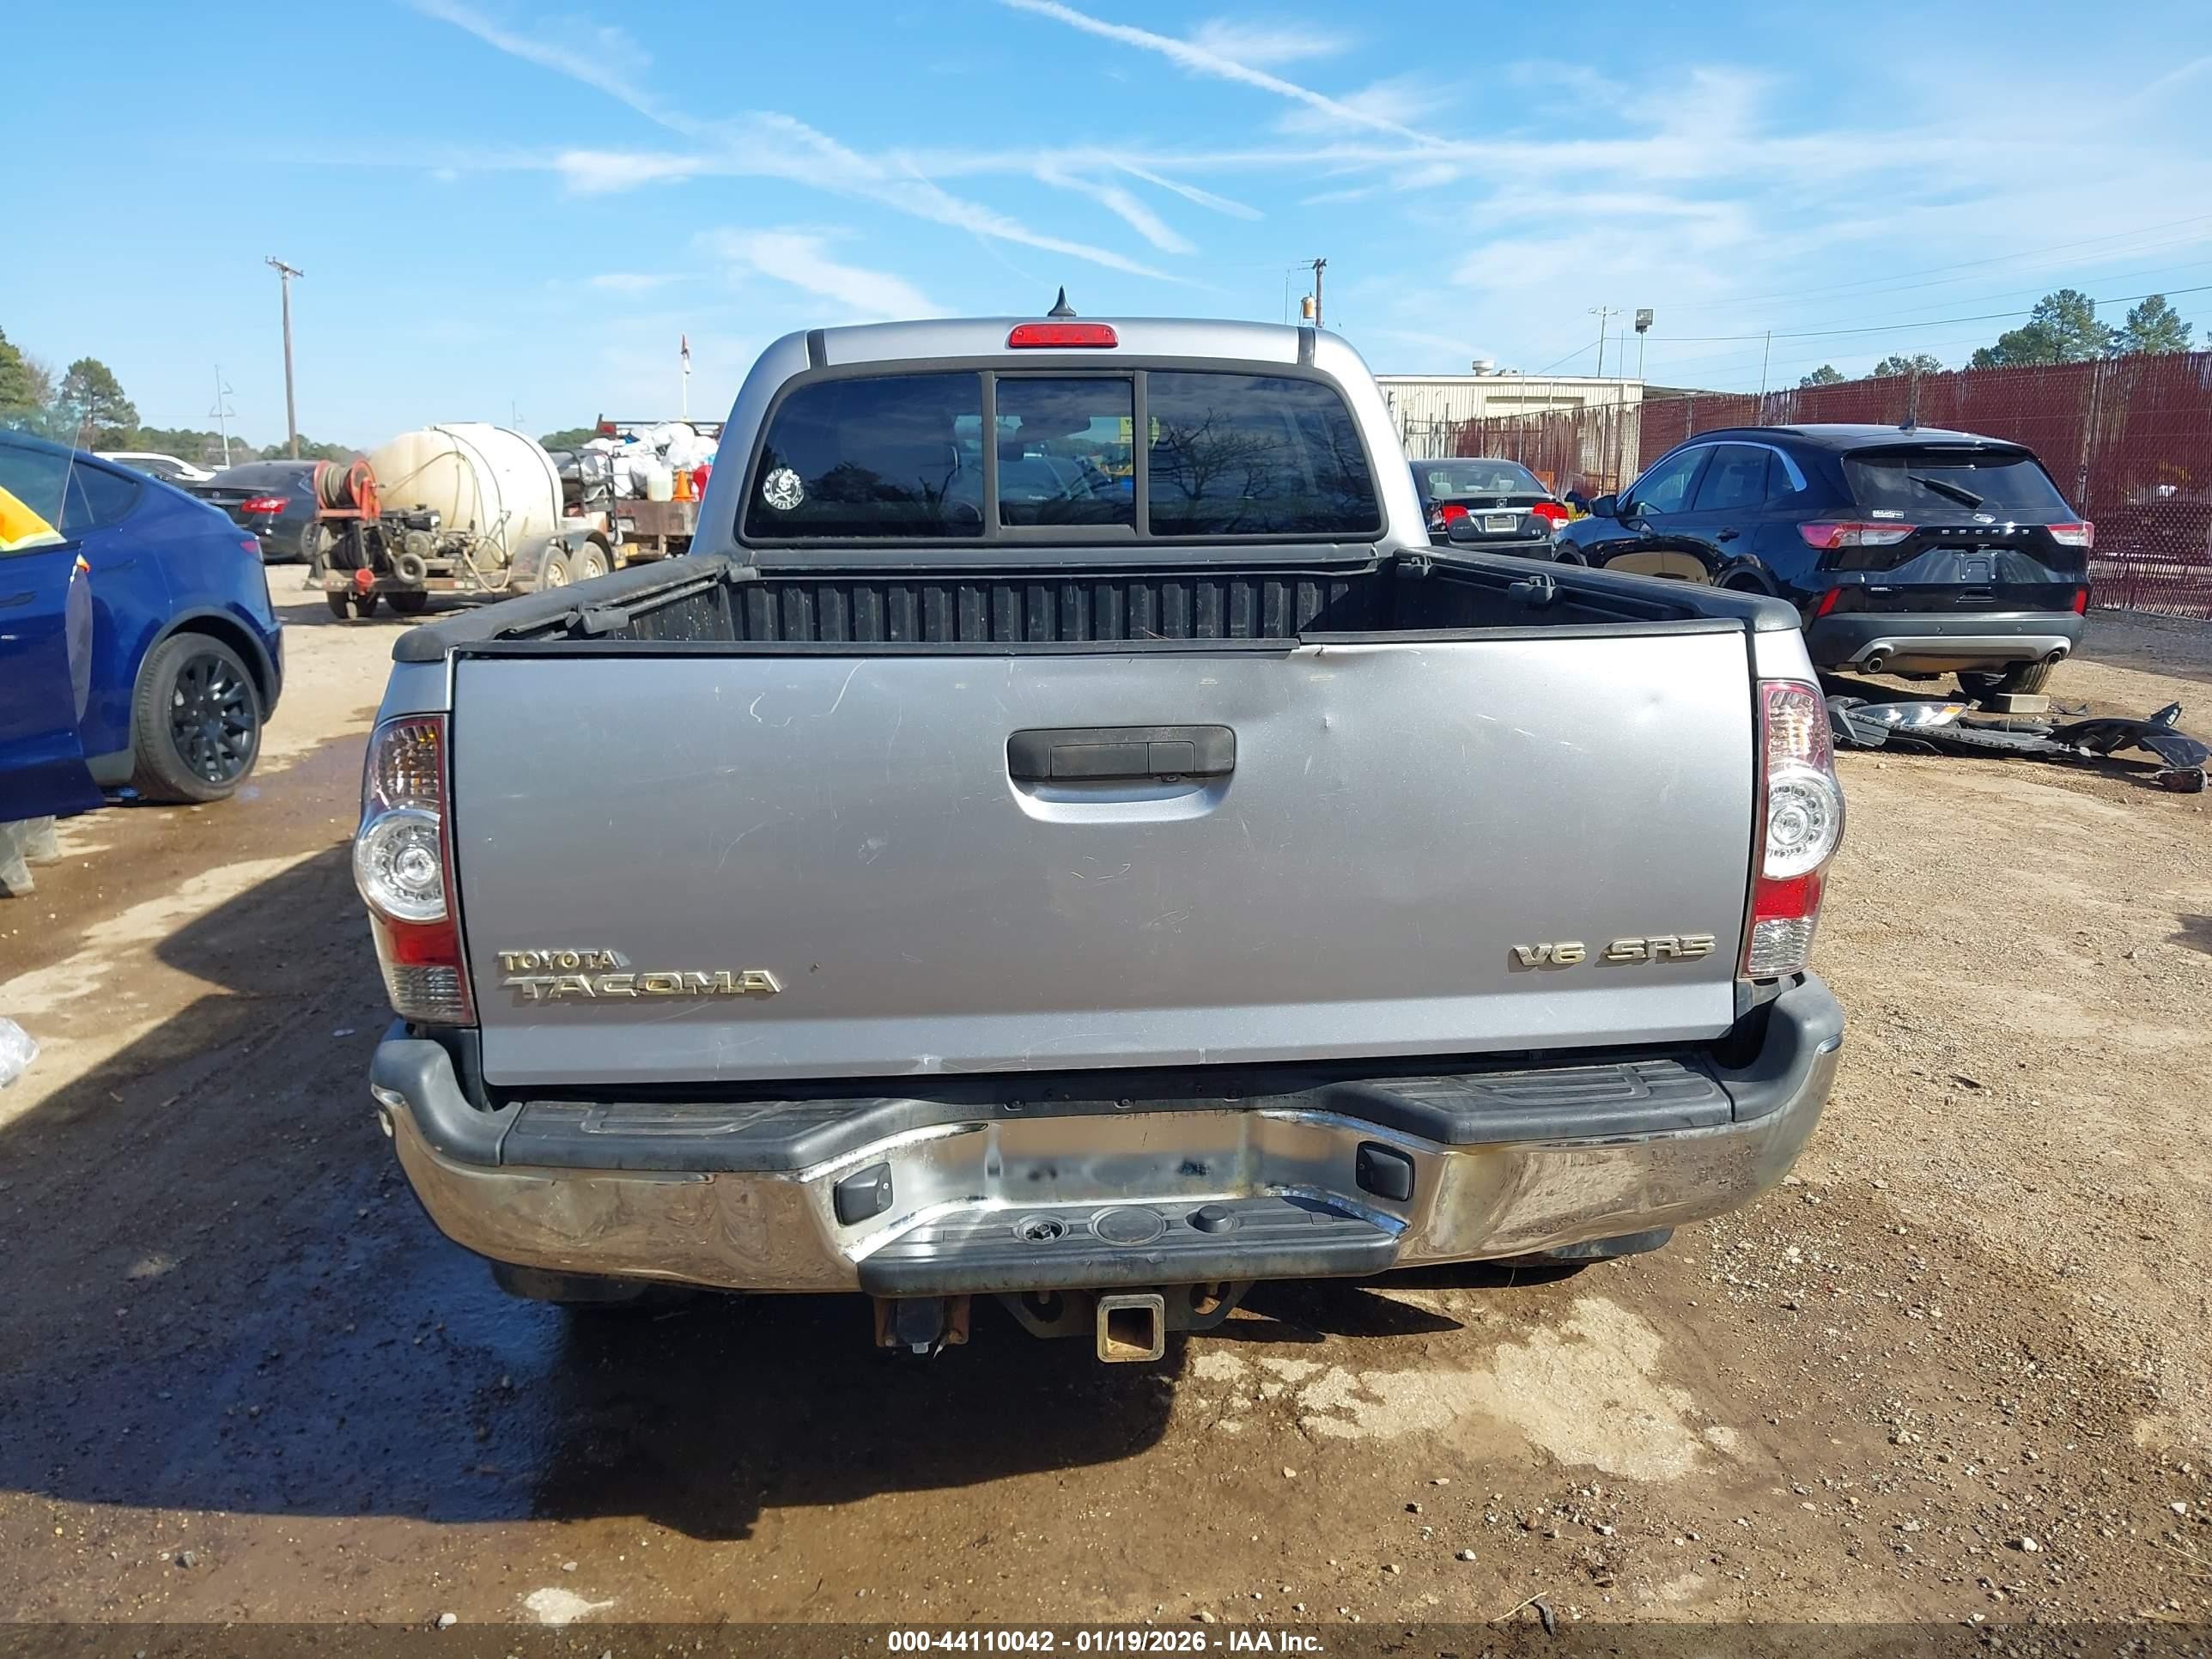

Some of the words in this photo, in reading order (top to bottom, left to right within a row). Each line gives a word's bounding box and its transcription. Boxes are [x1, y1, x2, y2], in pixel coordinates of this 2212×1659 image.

[498, 949, 622, 970] TOYOTA
[1513, 940, 1587, 966] V6
[1607, 934, 1716, 961] SR5
[503, 970, 781, 999] TACOMA
